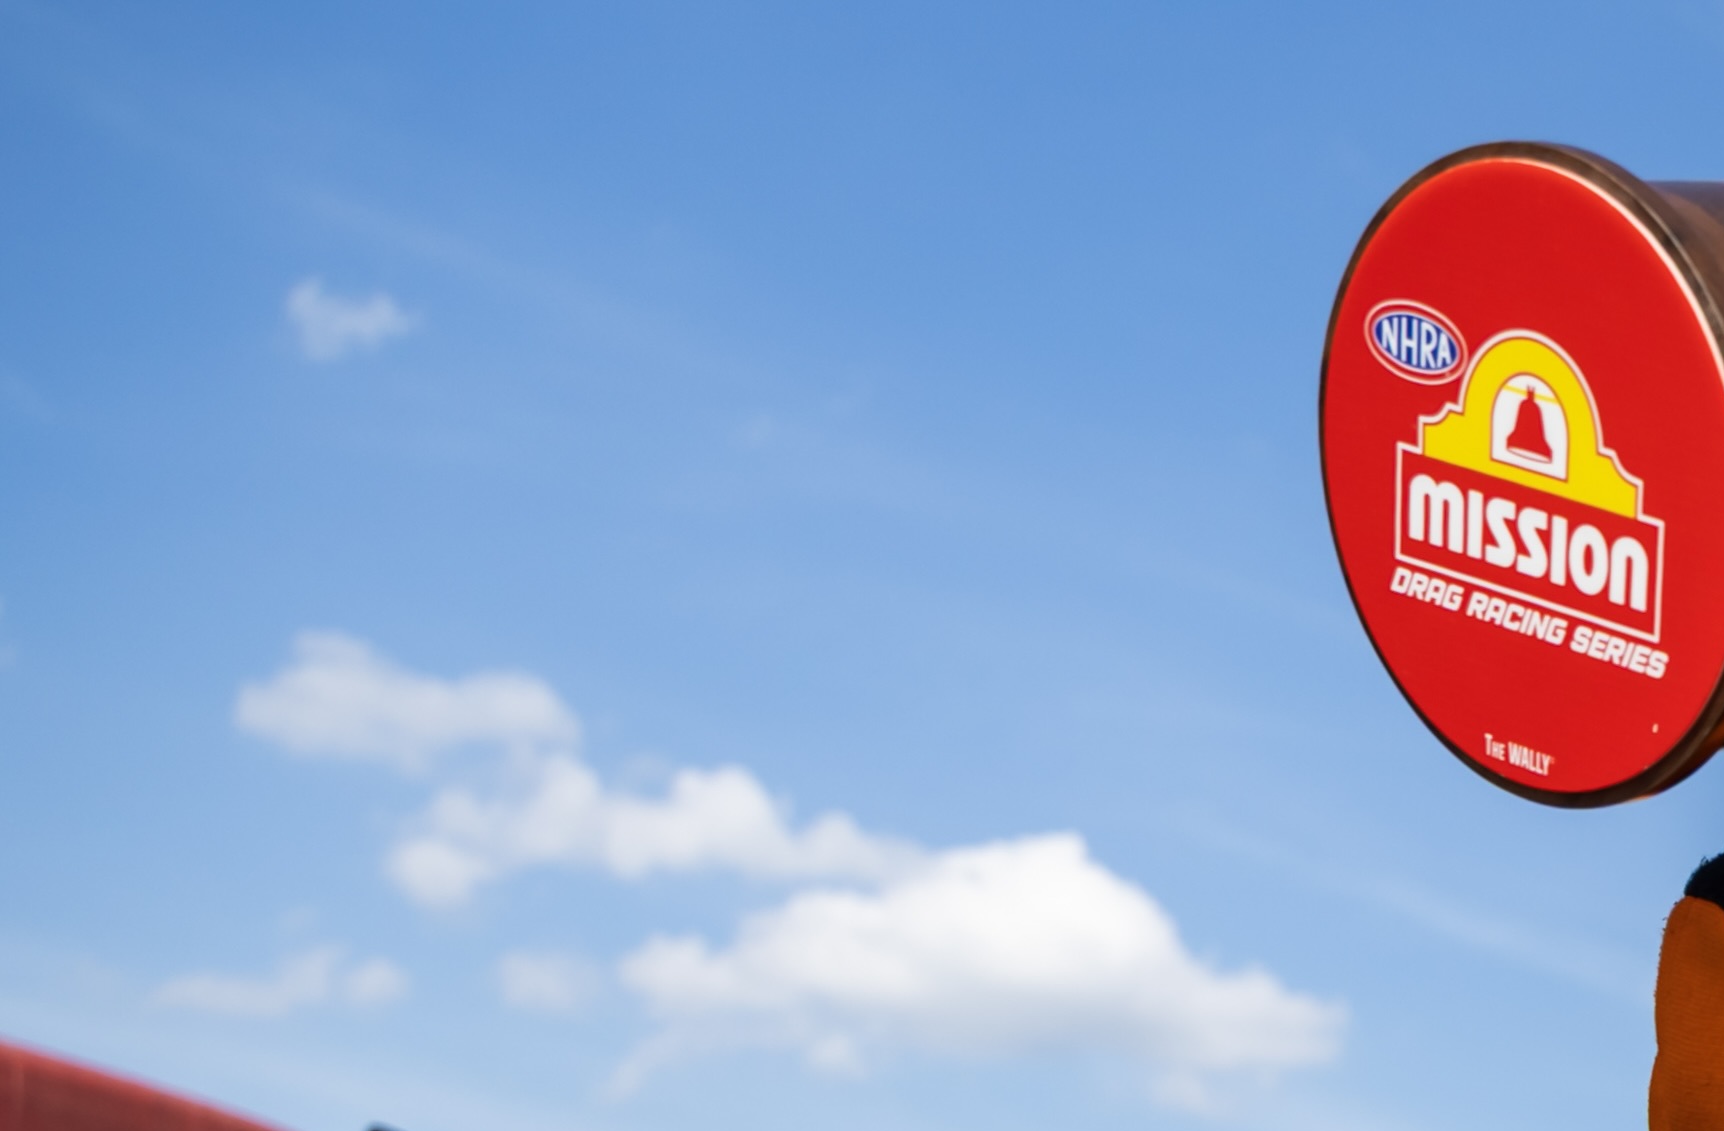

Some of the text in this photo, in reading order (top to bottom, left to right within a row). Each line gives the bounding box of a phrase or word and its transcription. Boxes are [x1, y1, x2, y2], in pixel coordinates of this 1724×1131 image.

[1381, 316, 1453, 369] NHRA
[1408, 474, 1649, 613] MISSION
[1390, 566, 1669, 679] DRAG RACING SERIES
[1507, 741, 1551, 776] WALLY
